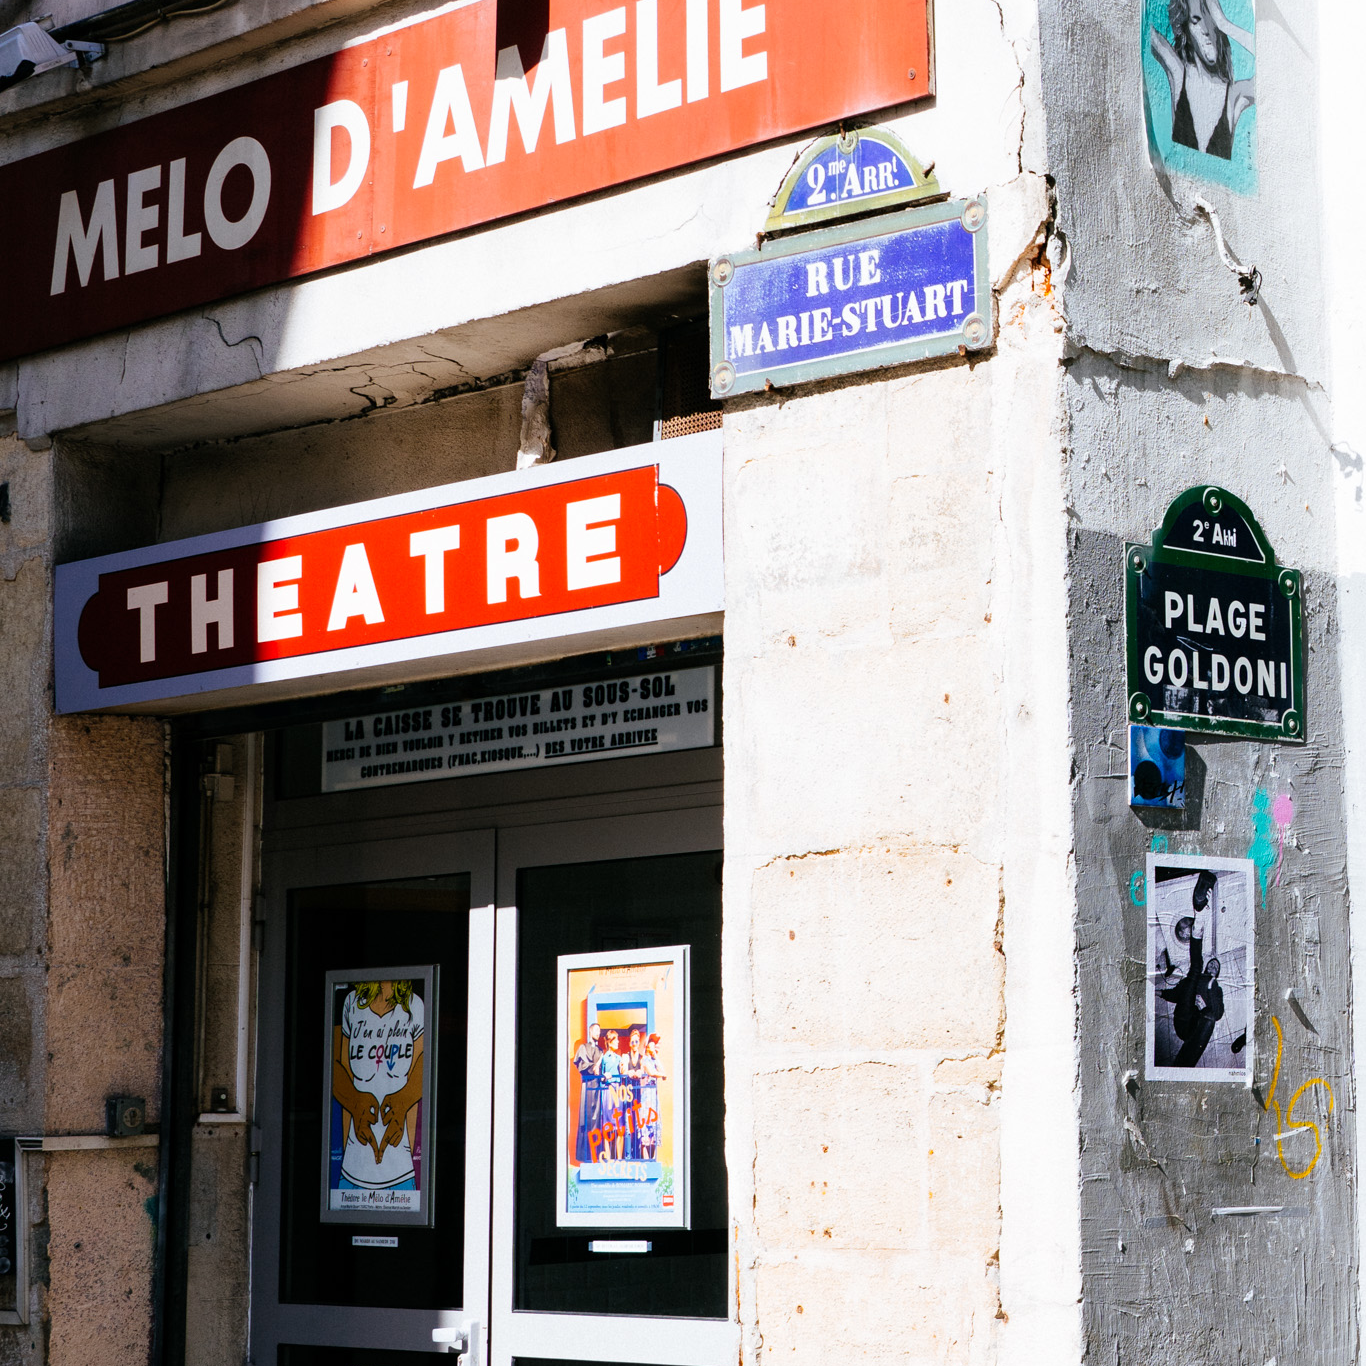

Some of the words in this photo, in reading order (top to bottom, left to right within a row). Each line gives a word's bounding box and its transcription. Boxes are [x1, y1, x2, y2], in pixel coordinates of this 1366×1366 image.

[50, 136, 272, 296] MELO
[806, 249, 881, 298] RUE
[728, 280, 968, 362] MARIE-STUART
[1192, 519, 1210, 542] 2e
[127, 492, 622, 663] THEATRE
[1164, 591, 1266, 641] PLAGE
[1143, 646, 1287, 699] GOLDONI
[327, 747, 354, 763] MERCI
[359, 746, 372, 759] DE
[376, 742, 397, 757] BIEN
[403, 735, 443, 753] VOULOIR
[448, 735, 455, 746] Y
[460, 728, 503, 745] RETIRER
[508, 726, 528, 738] VOS
[533, 718, 576, 736] BILLETS
[582, 715, 596, 728] ET
[623, 703, 681, 724] ECHANGER
[687, 699, 708, 714] VOS
[345, 721, 364, 742] LA
[373, 709, 432, 738] CAISSE
[441, 707, 462, 728] SE
[471, 694, 541, 725] TROUVE
[550, 689, 573, 712] AU
[583, 675, 675, 708] SOUS-SOL
[361, 757, 443, 778] CONTREMARQUES
[545, 741, 565, 755] DES
[570, 736, 604, 753] VOTRE
[350, 1045, 364, 1060] LE
[368, 1043, 413, 1067] COUPLE
[353, 1020, 373, 1039] J'en
[376, 1024, 386, 1039] ai
[386, 1020, 409, 1045] plein
[607, 1084, 634, 1110] NOS
[587, 1099, 658, 1164] petits
[598, 1151, 647, 1181] SECRETS
